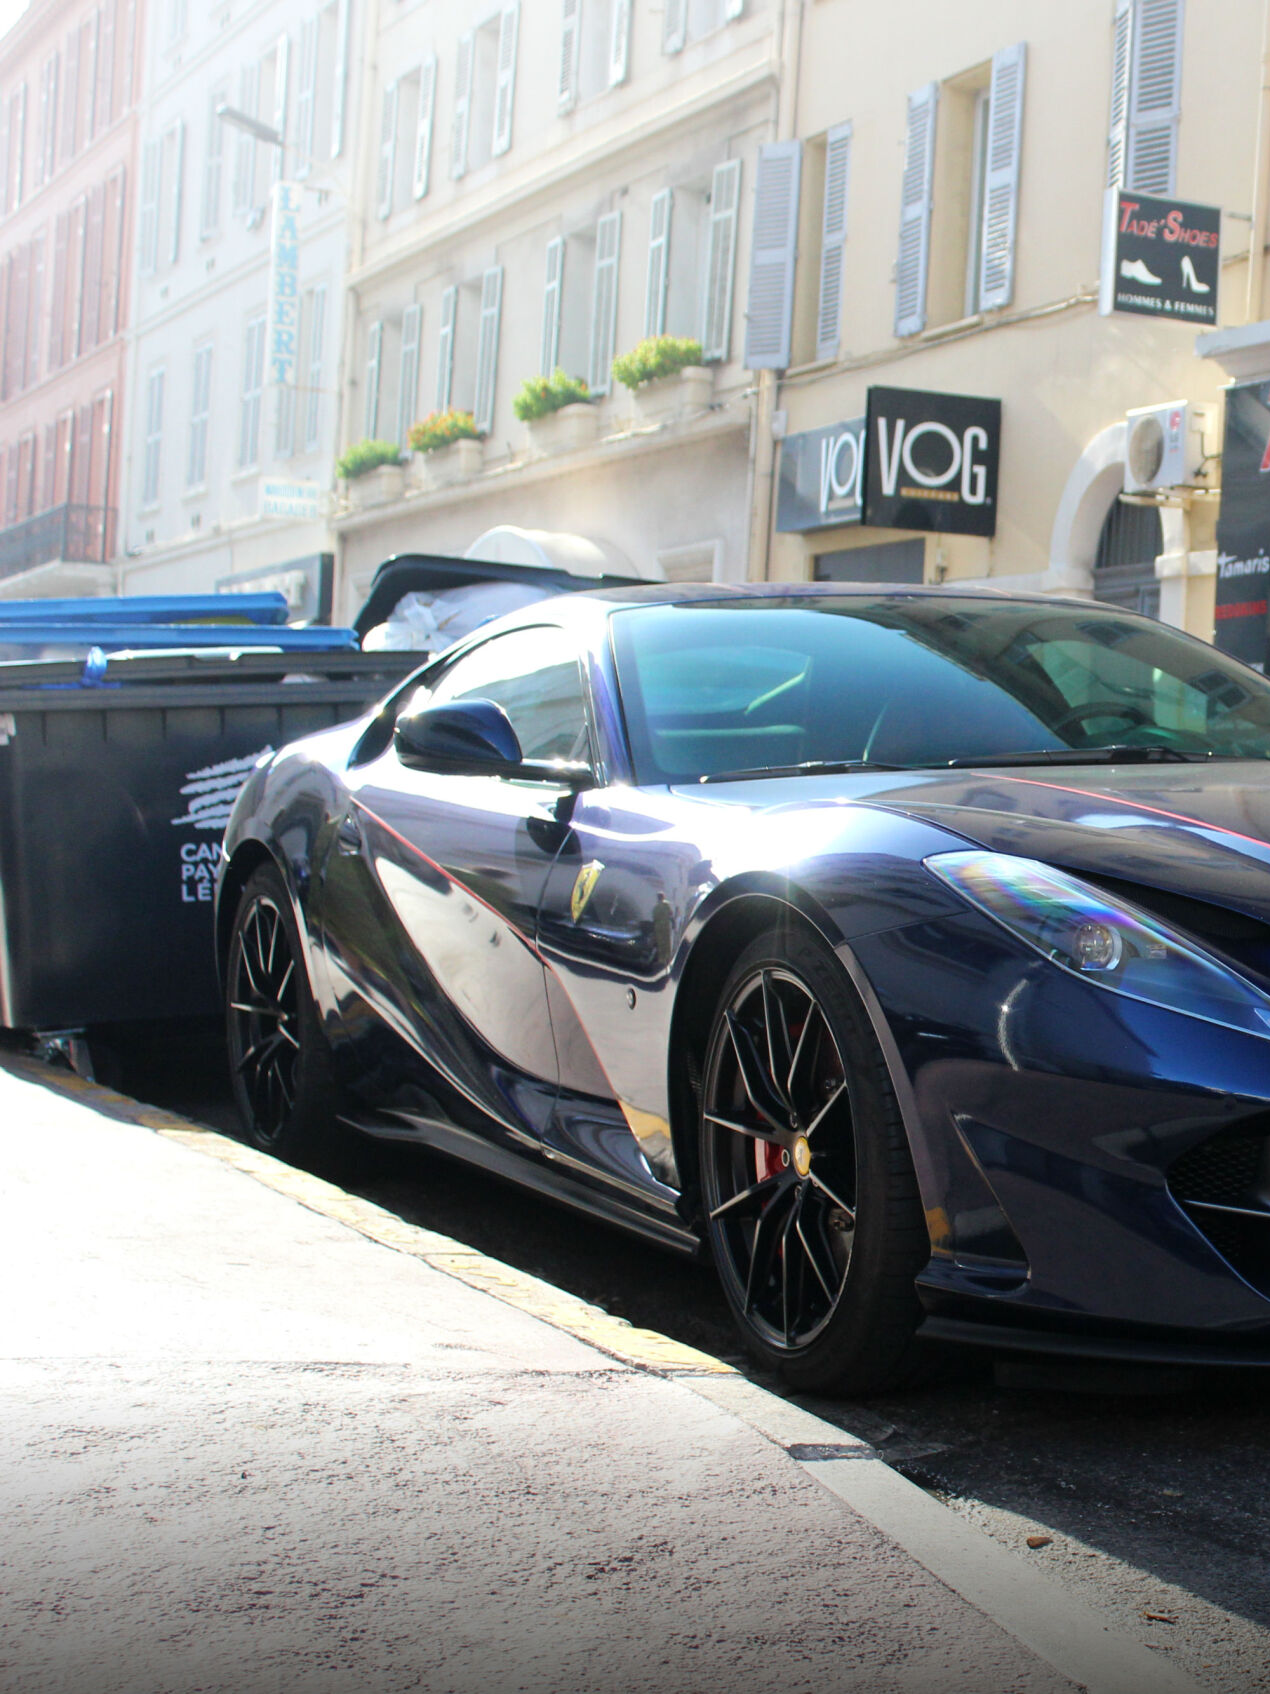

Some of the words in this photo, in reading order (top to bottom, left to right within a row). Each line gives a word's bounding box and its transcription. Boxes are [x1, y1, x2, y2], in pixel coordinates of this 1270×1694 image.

[273, 186, 300, 383] LAMBERT
[1117, 292, 1162, 310] HOMMES
[1164, 299, 1173, 312] &
[1174, 301, 1215, 317] FEMMES
[877, 416, 989, 505] VOG
